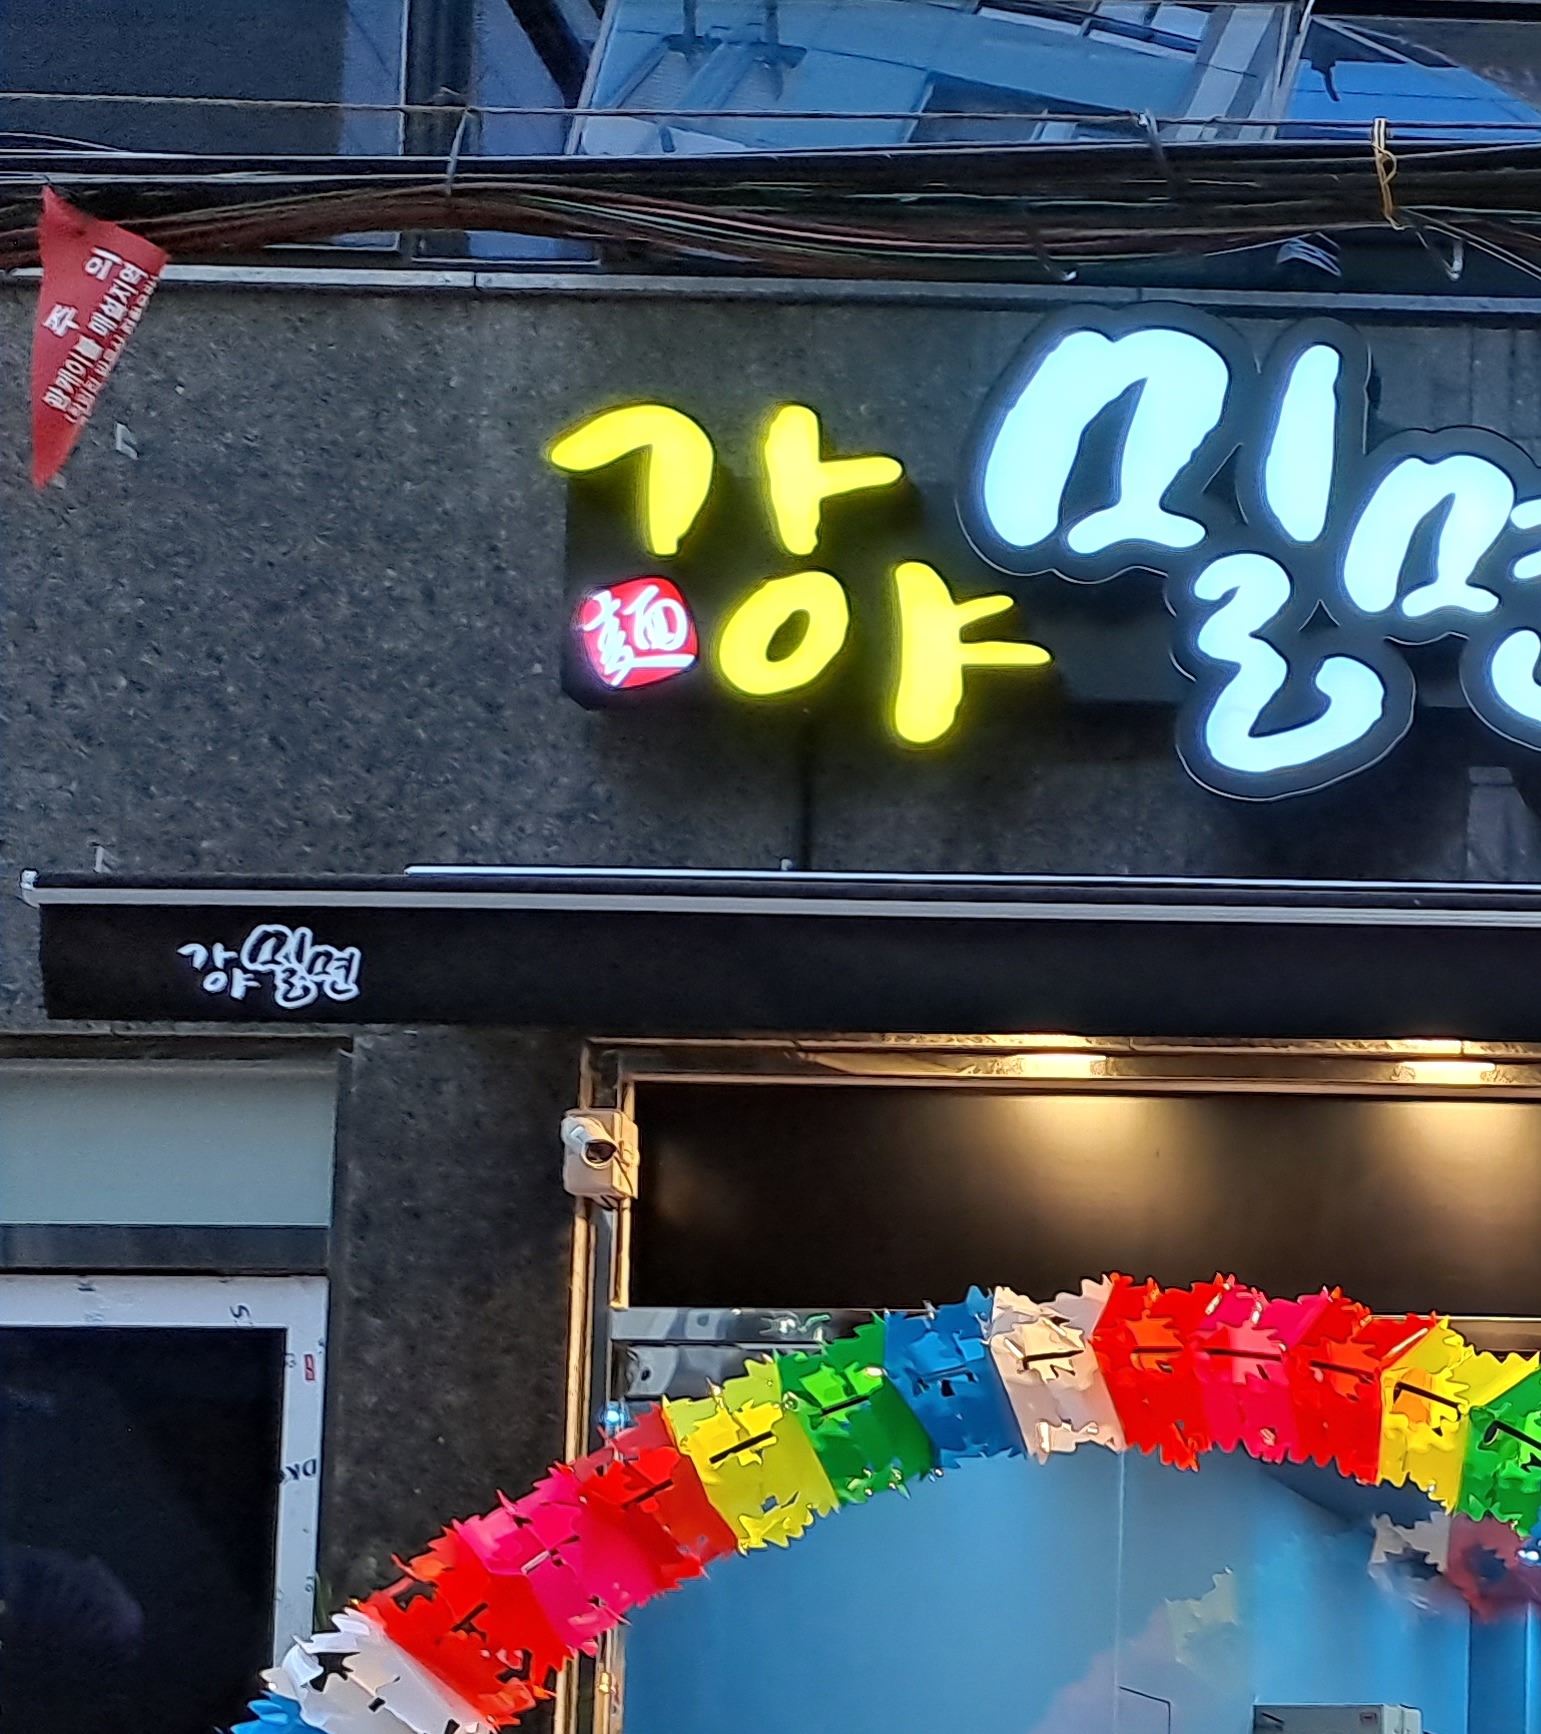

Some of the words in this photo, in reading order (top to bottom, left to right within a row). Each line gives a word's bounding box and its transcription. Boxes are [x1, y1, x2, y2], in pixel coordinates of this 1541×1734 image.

[547, 400, 1055, 748] 가야
[176, 942, 262, 1000] 가야
[240, 923, 361, 1009] 밀면
